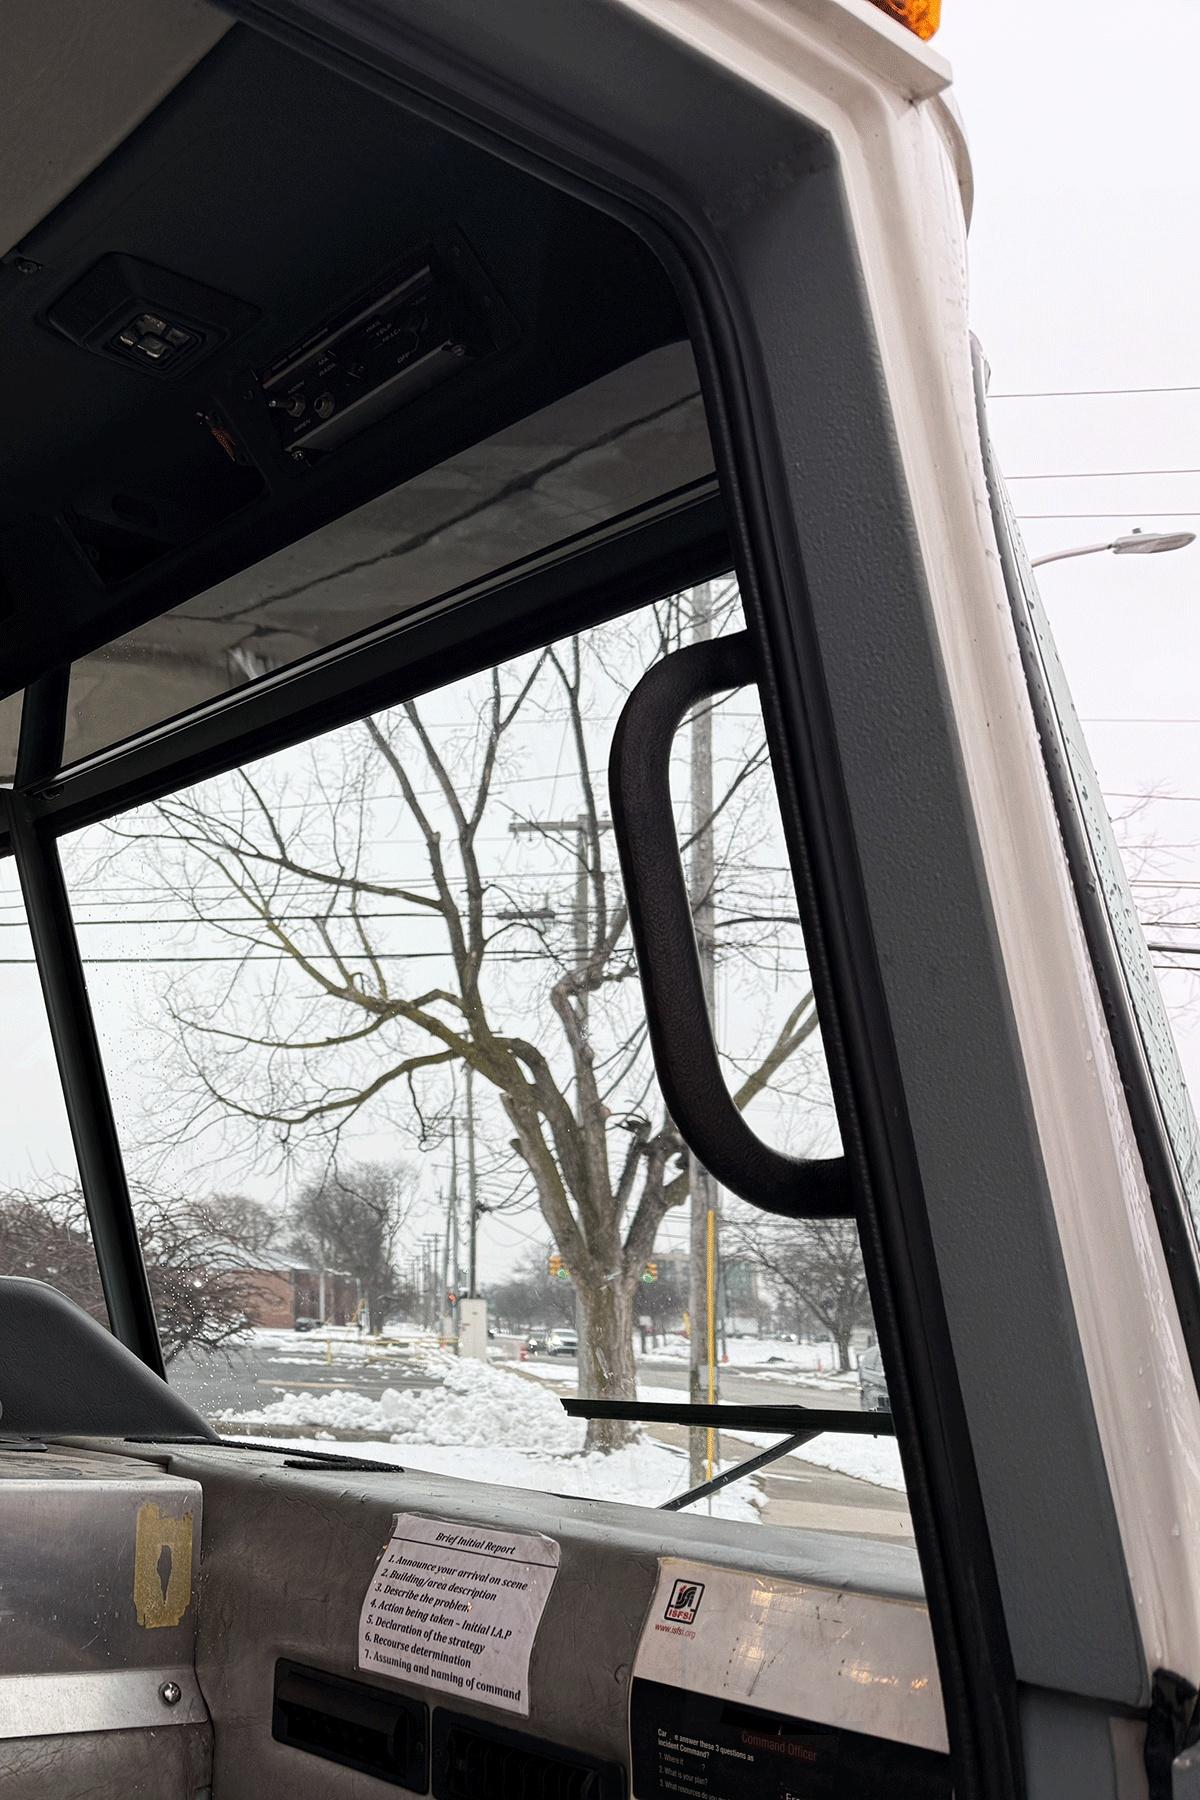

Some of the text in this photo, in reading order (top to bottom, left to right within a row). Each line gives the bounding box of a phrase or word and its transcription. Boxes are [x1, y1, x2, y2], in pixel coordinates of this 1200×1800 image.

[435, 1532, 516, 1555] Brief Initial Report
[380, 1568, 497, 1601] 2. Building/area description
[388, 1554, 528, 1591] 1. Announce your arrival on scene
[374, 1582, 382, 1593] 3.
[383, 1584, 421, 1601] Describe
[419, 1593, 435, 1605] the
[370, 1598, 377, 1608] 4.
[378, 1600, 405, 1615] Action
[405, 1605, 429, 1623] being
[429, 1613, 455, 1627] taken
[461, 1620, 491, 1637] Initial
[668, 1609, 693, 1621] ISFSI
[364, 1631, 471, 1668] 6. Recourse determination
[366, 1614, 486, 1655] 5. Declaration of the strategy
[364, 1648, 521, 1701] 7. Assuming and naming of command
[787, 1743, 817, 1762] Officer
